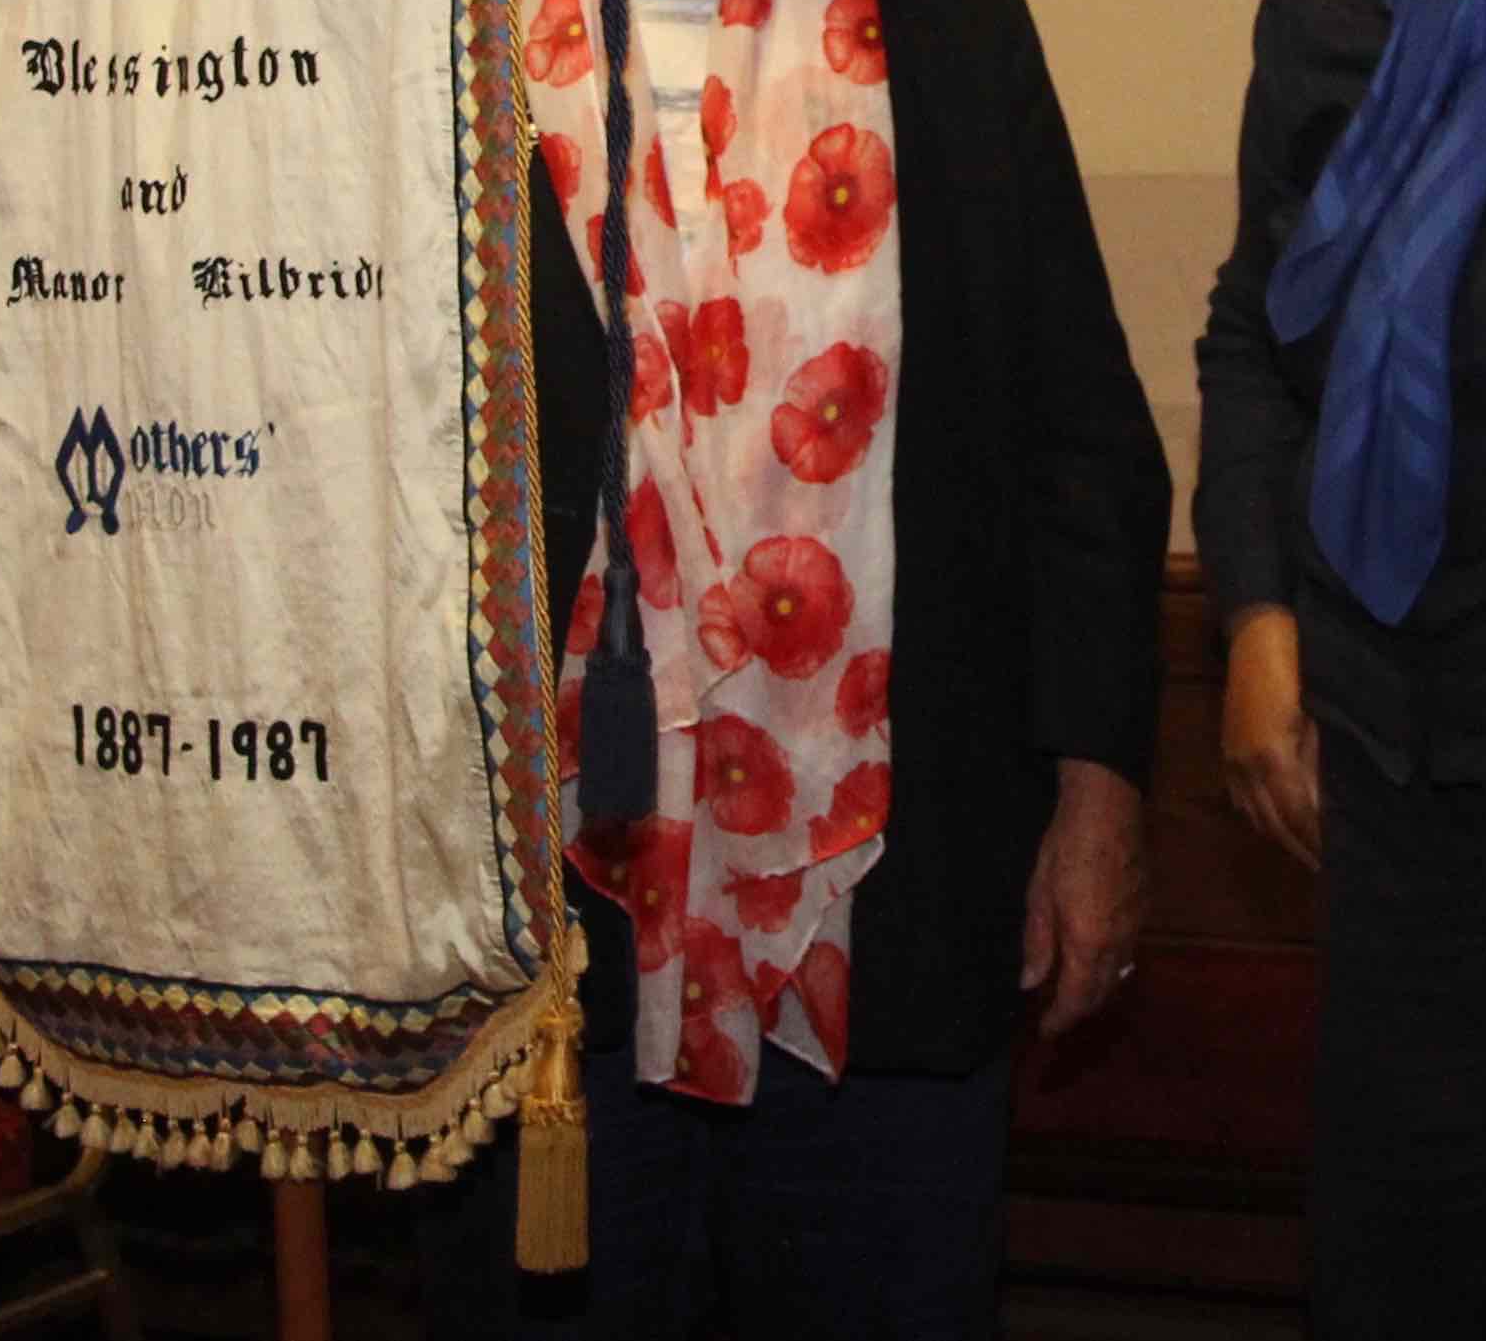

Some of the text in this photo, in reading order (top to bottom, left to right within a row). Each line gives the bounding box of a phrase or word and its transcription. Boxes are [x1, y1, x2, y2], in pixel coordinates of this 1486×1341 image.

[21, 36, 322, 102] Blessington
[121, 164, 189, 215] and
[7, 253, 127, 308] Manor
[72, 704, 329, 782] 1887-1987
